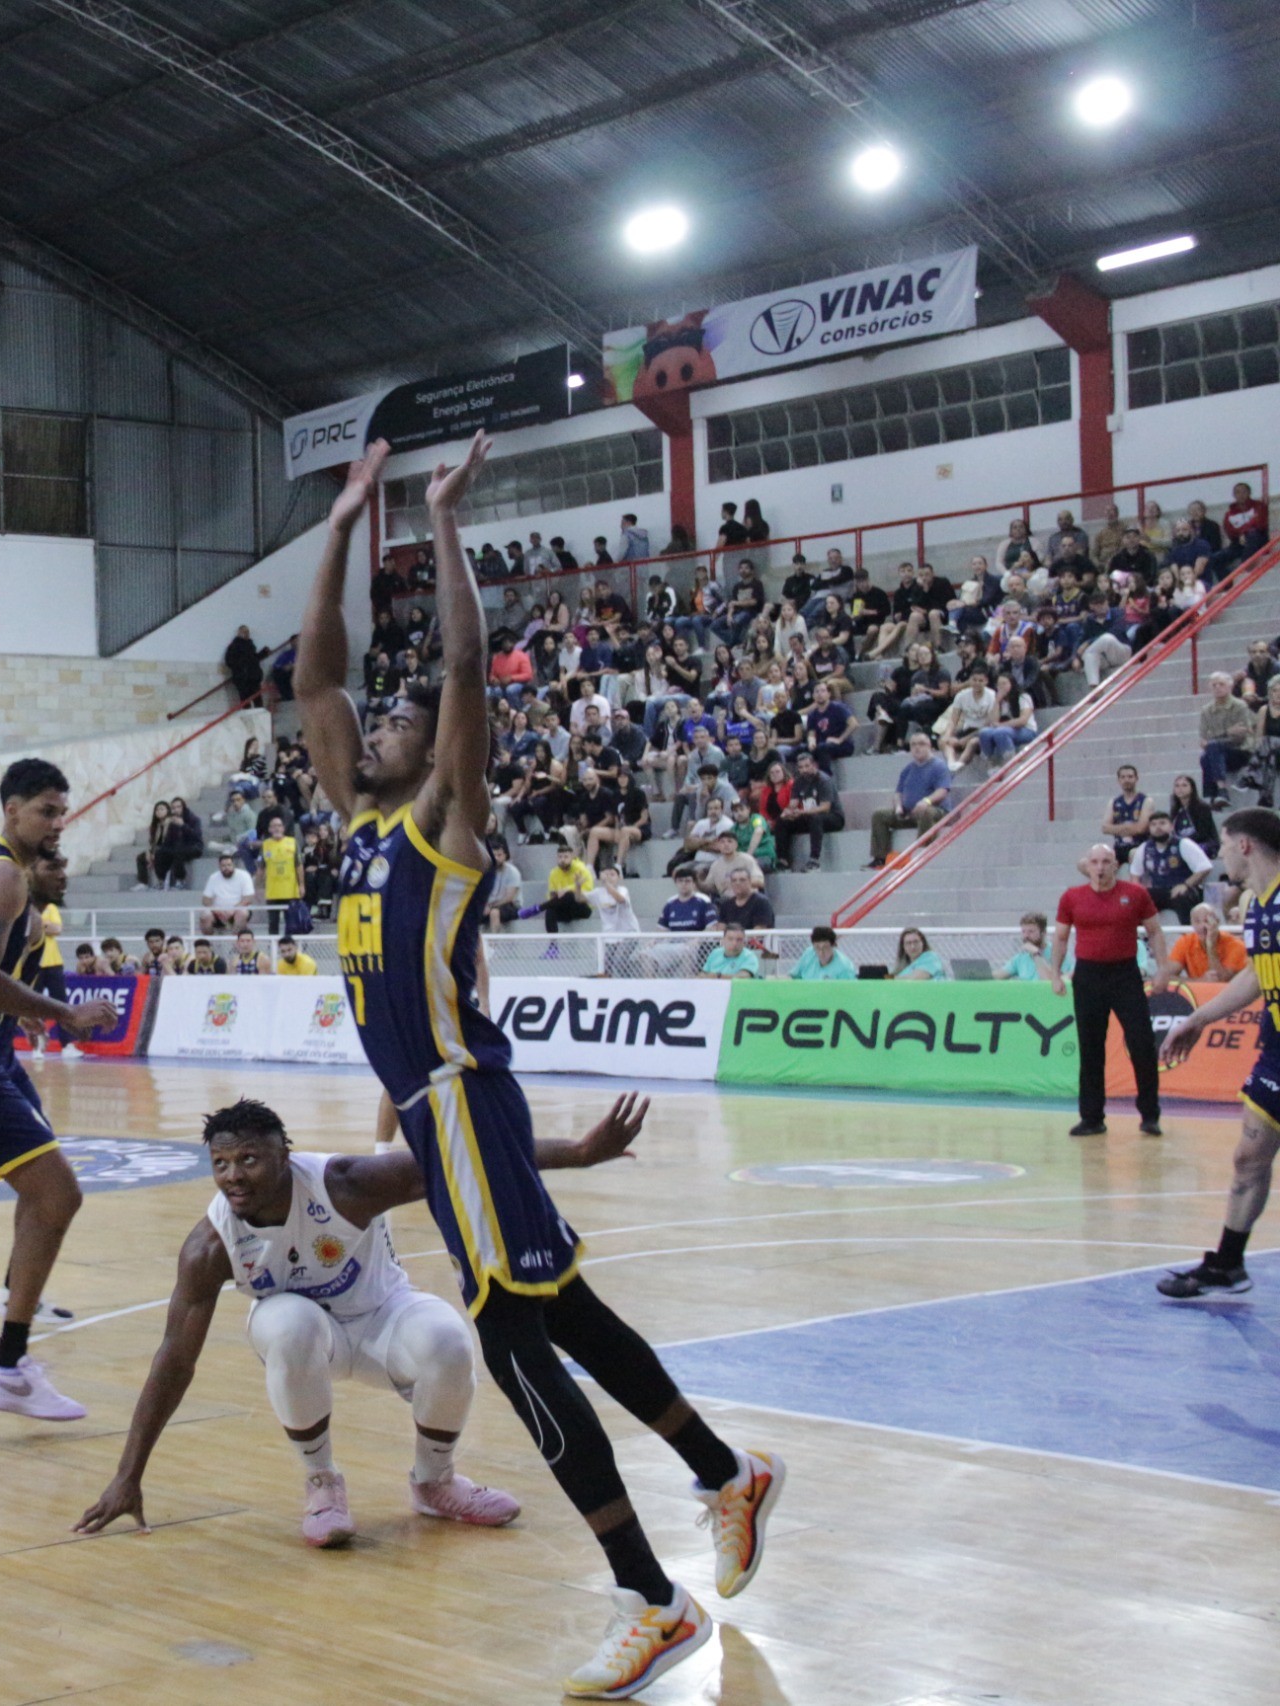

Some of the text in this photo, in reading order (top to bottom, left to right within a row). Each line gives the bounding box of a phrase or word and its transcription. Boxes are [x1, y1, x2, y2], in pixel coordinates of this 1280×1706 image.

[820, 267, 942, 323] VINAC
[820, 306, 934, 347] consórcios
[415, 372, 516, 405] Segurança Eletrônica
[432, 395, 495, 420] Energia Solar
[312, 418, 358, 449] PRC
[733, 1008, 1075, 1058] PENALTY
[1206, 1029, 1245, 1050] DE
